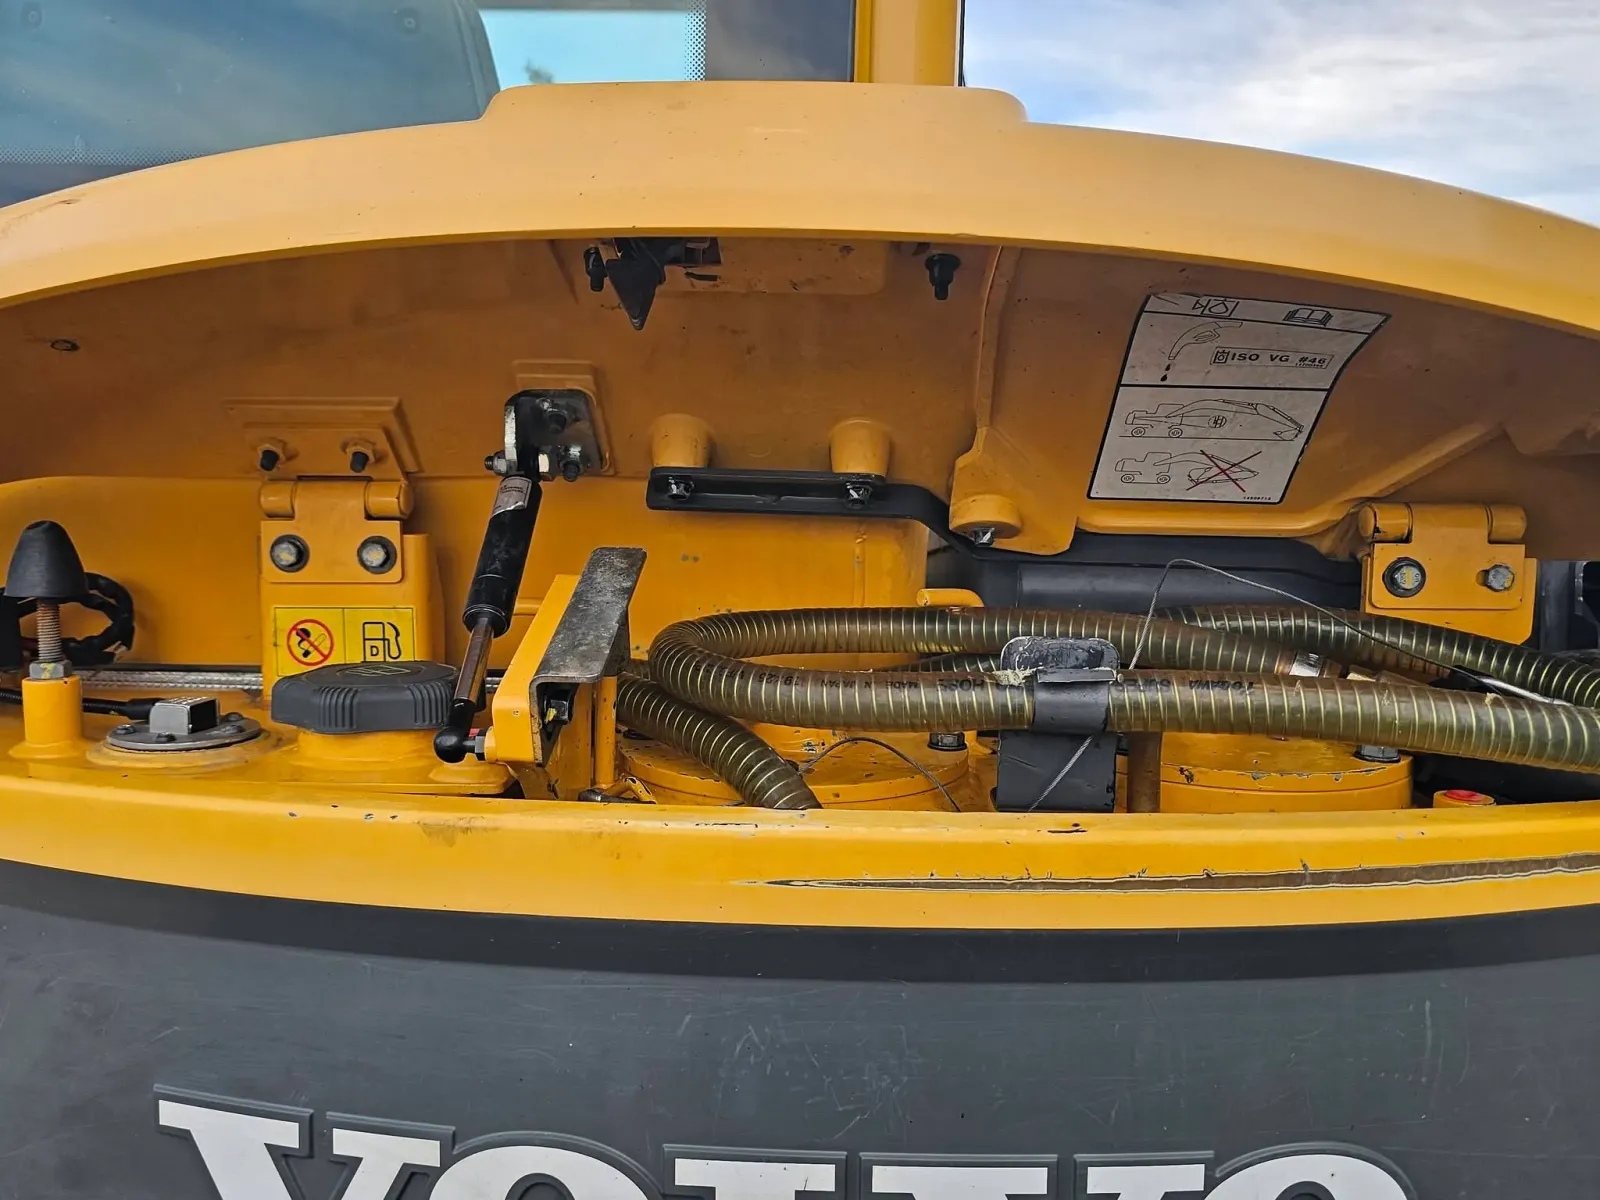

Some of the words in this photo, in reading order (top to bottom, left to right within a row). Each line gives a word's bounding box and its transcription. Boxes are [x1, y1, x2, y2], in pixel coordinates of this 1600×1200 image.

[1231, 352, 1260, 361] ISO
[1269, 354, 1290, 362] VG
[1299, 356, 1327, 364] #46
[370, 645, 379, 657] D
[820, 679, 857, 689] JAPAN
[886, 680, 918, 690] MADE
